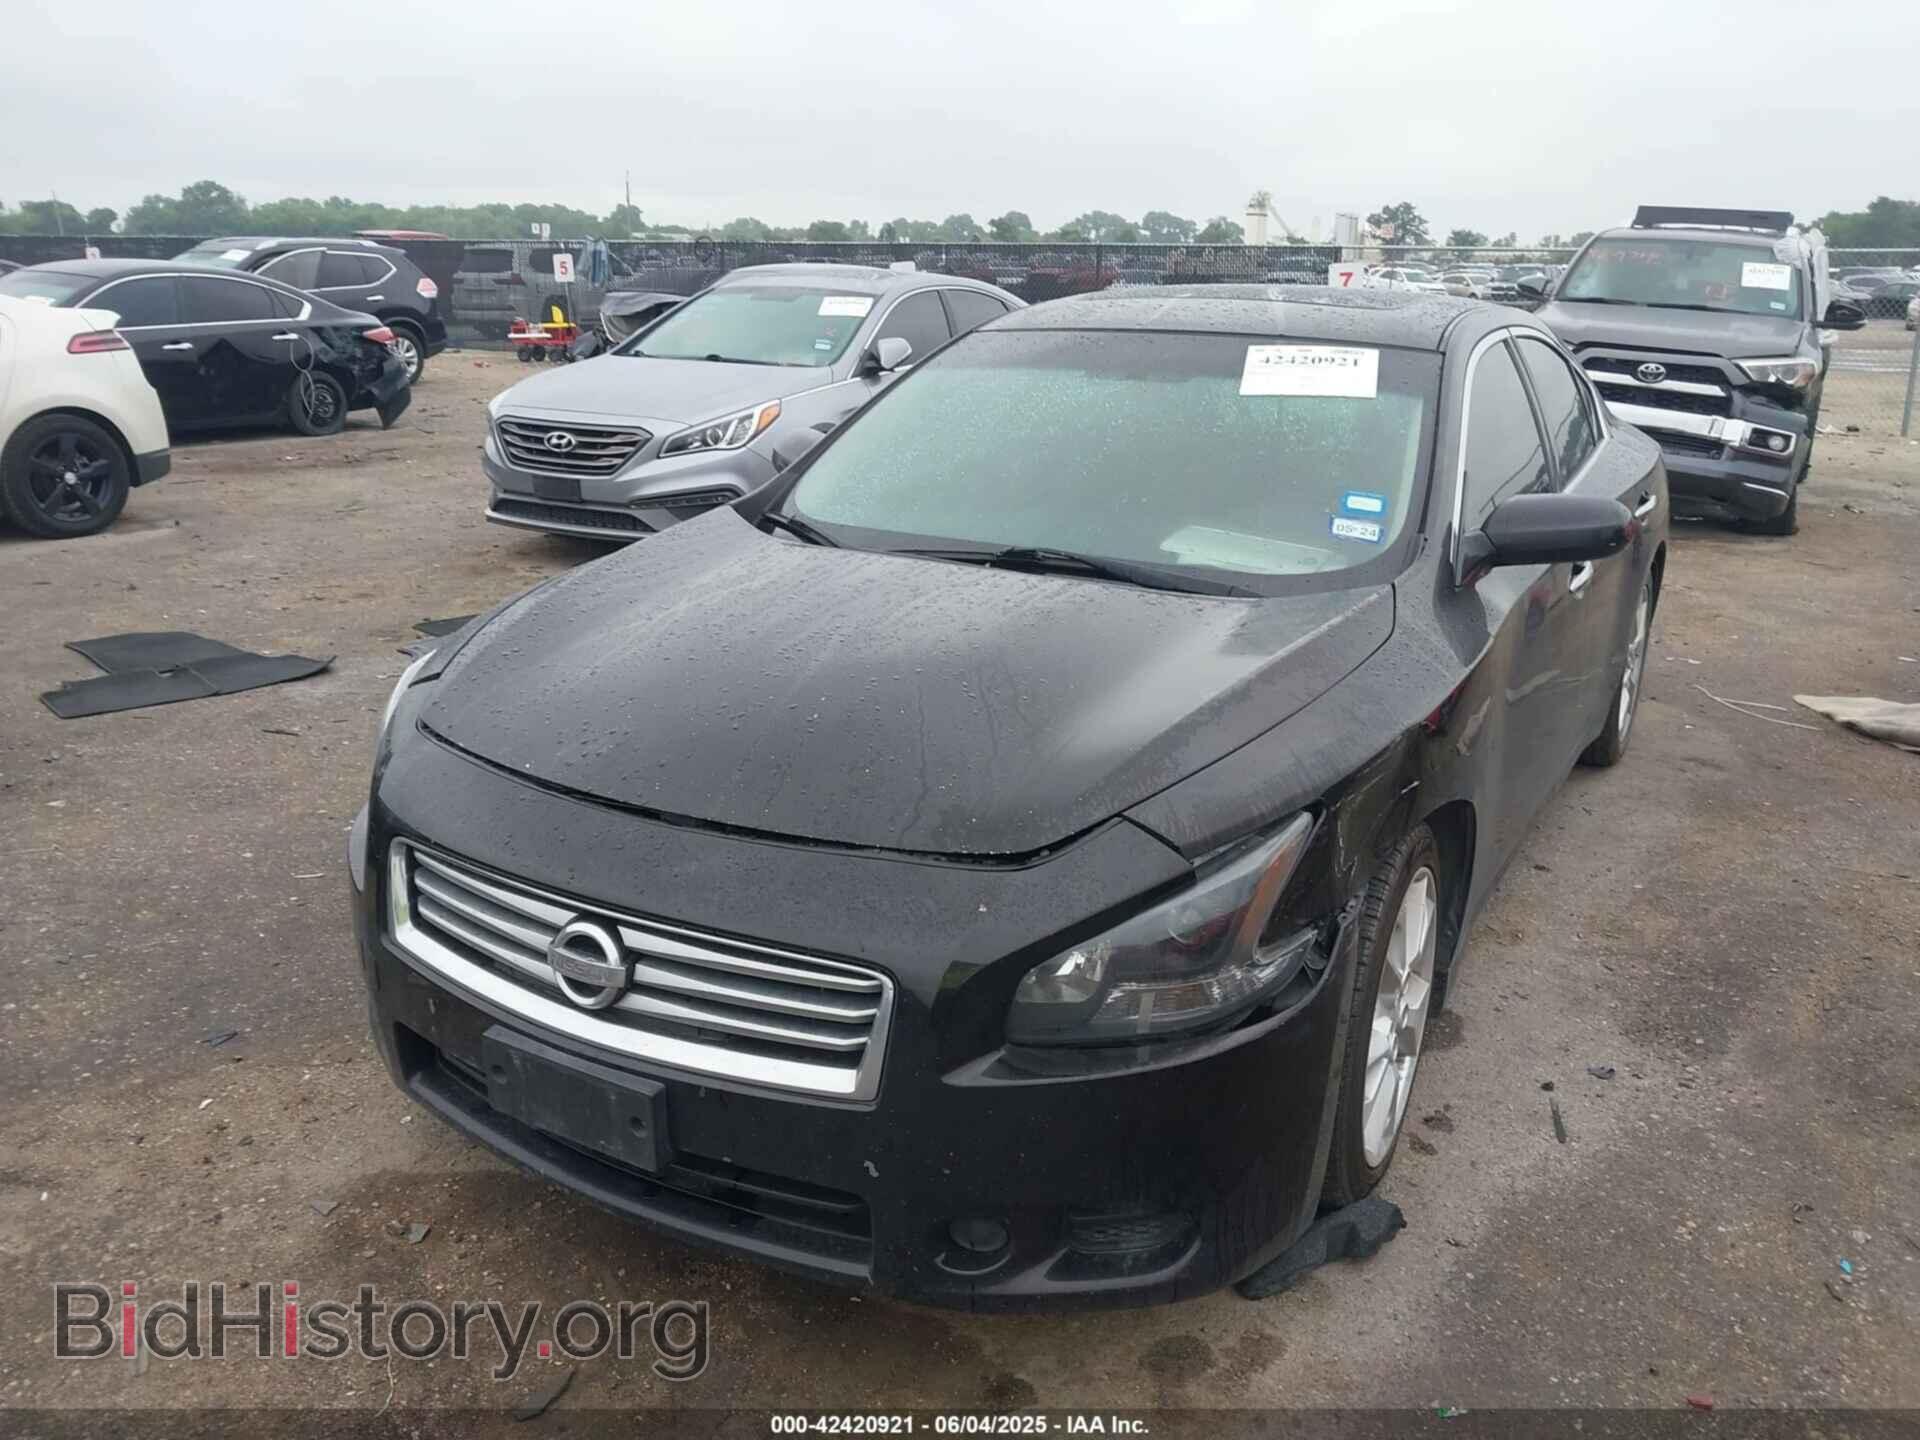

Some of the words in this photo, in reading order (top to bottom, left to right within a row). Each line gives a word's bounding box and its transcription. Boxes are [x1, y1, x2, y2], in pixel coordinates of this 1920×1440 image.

[559, 261, 568, 275] 5
[1339, 272, 1354, 287] 7
[1258, 355, 1360, 368] 42420921
[553, 955, 612, 984] NISS
